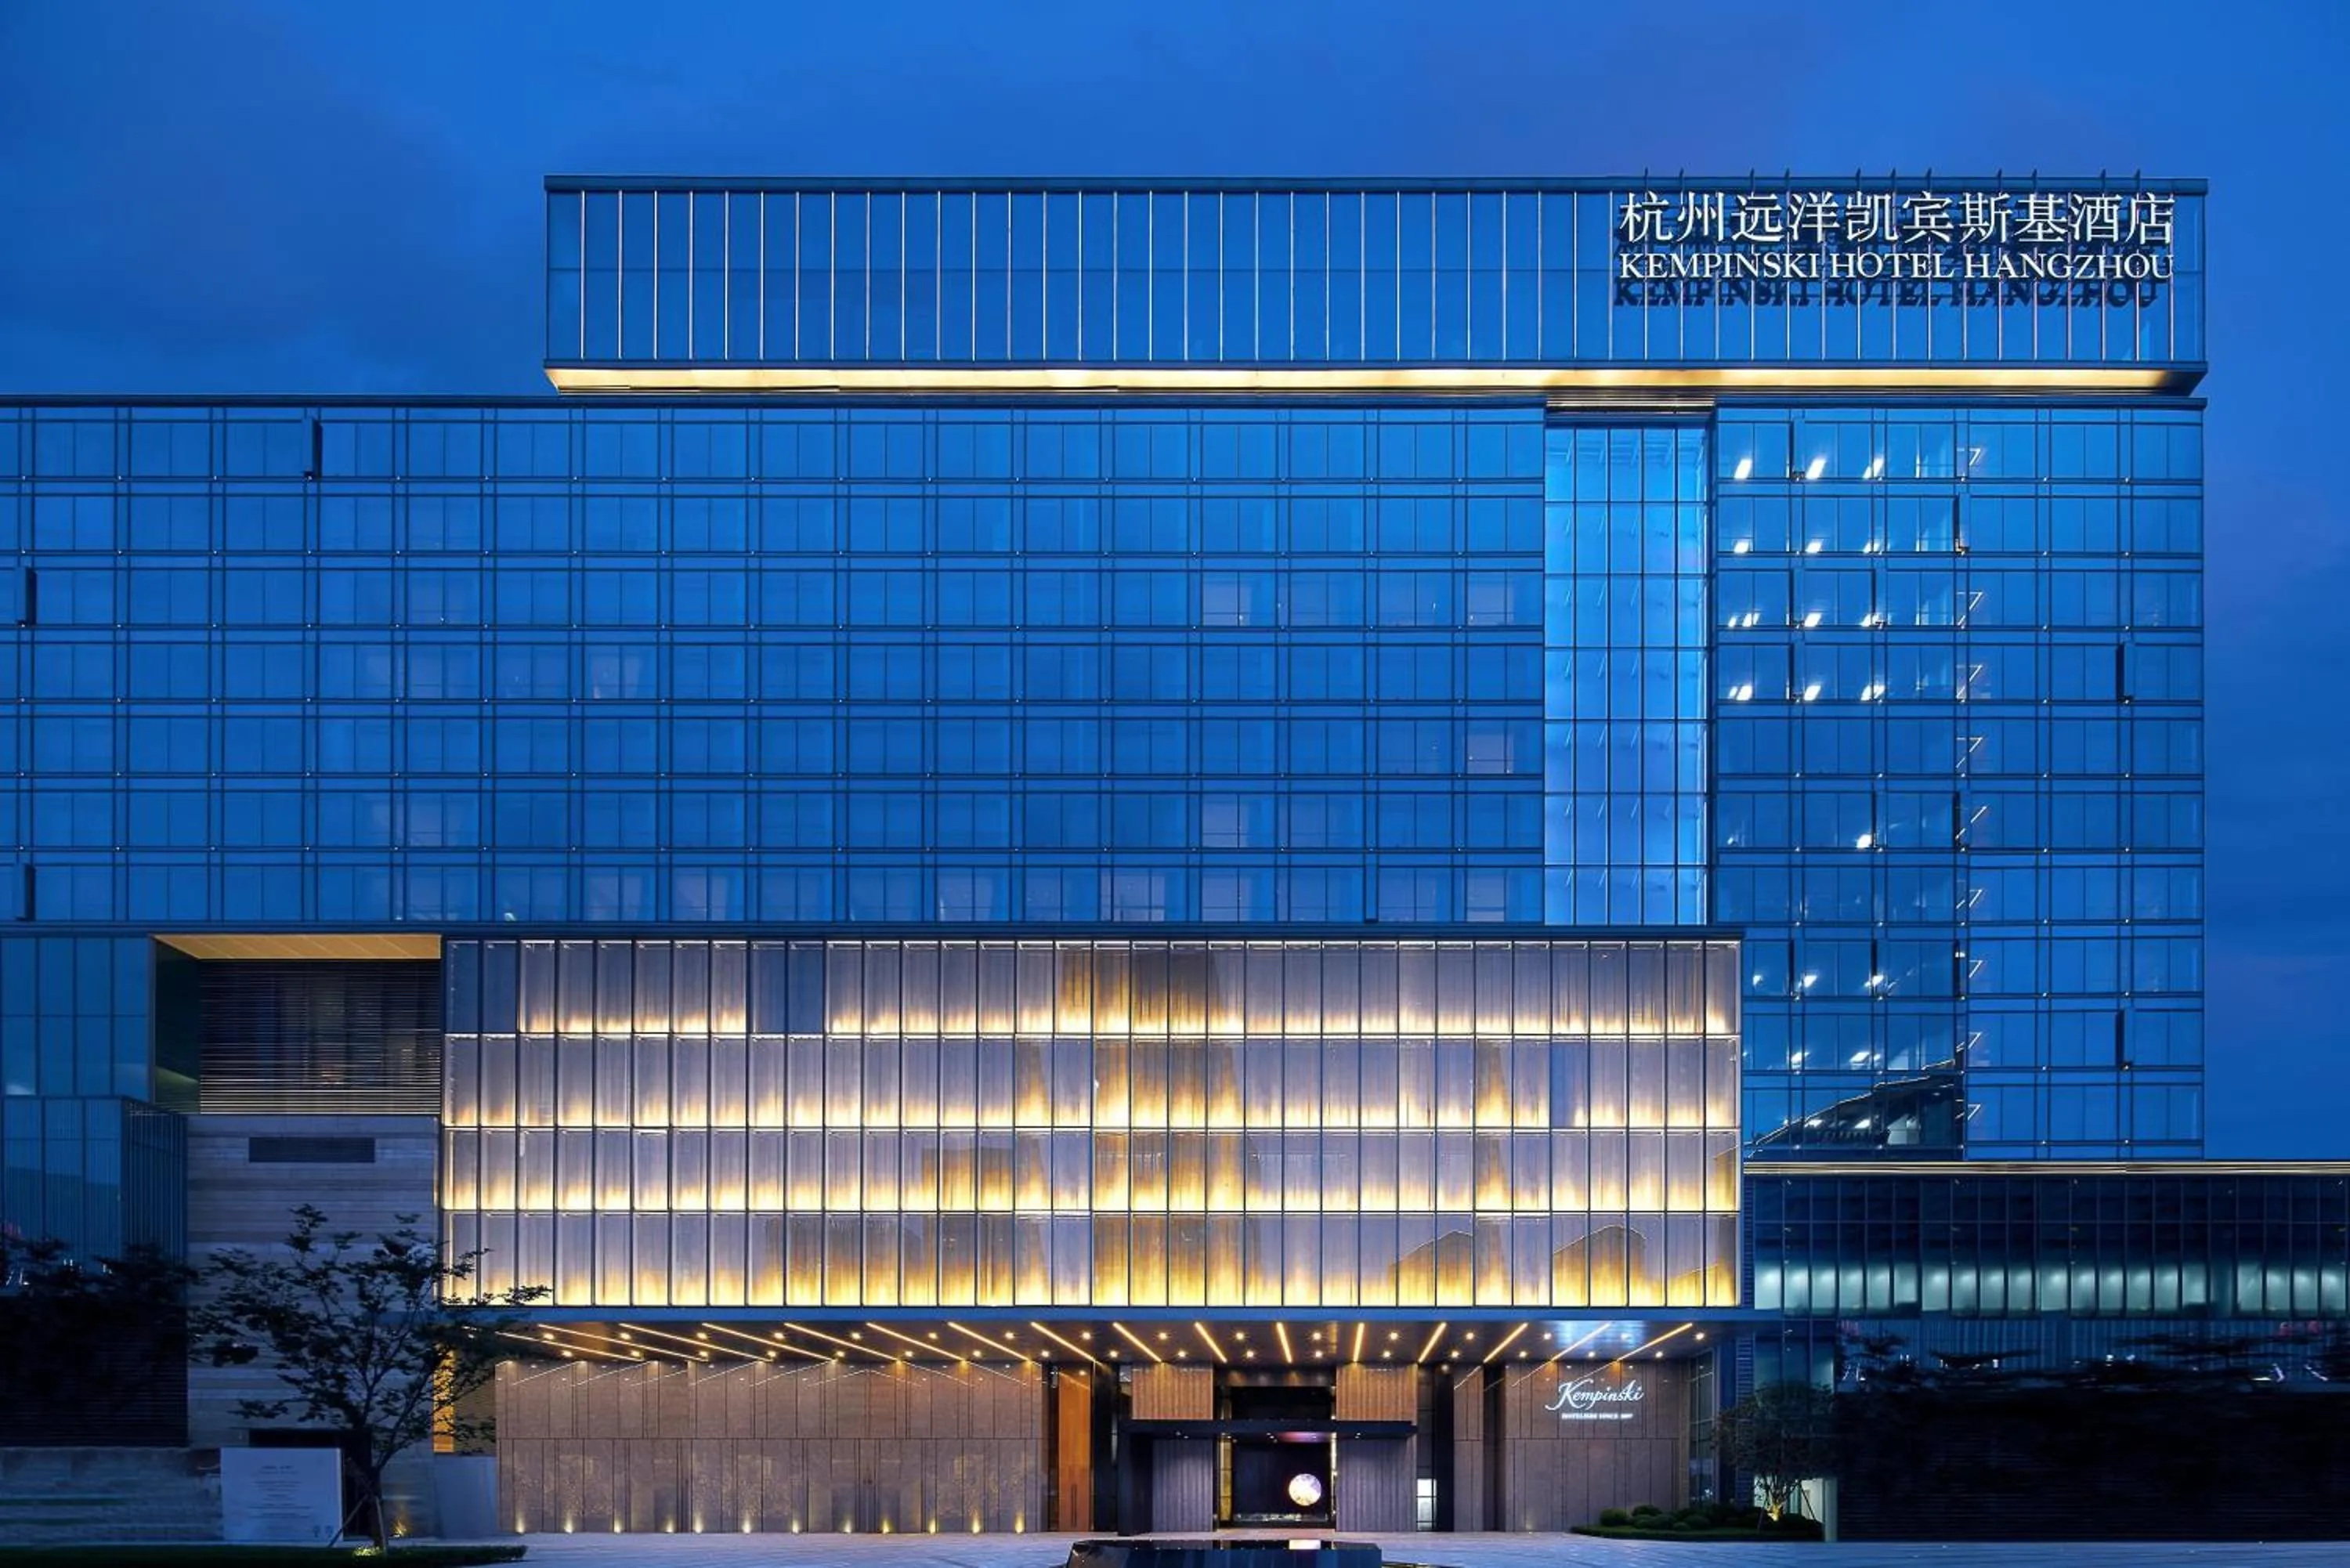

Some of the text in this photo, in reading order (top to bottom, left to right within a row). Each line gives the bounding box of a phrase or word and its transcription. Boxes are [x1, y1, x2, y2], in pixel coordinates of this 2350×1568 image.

[1619, 190, 2175, 244] 杭州远洋凯宾斯基酒店
[1619, 252, 2175, 279] KEMPINSKI HOTEL HANGZHOU
[1545, 1378, 1643, 1410] Kempinski
